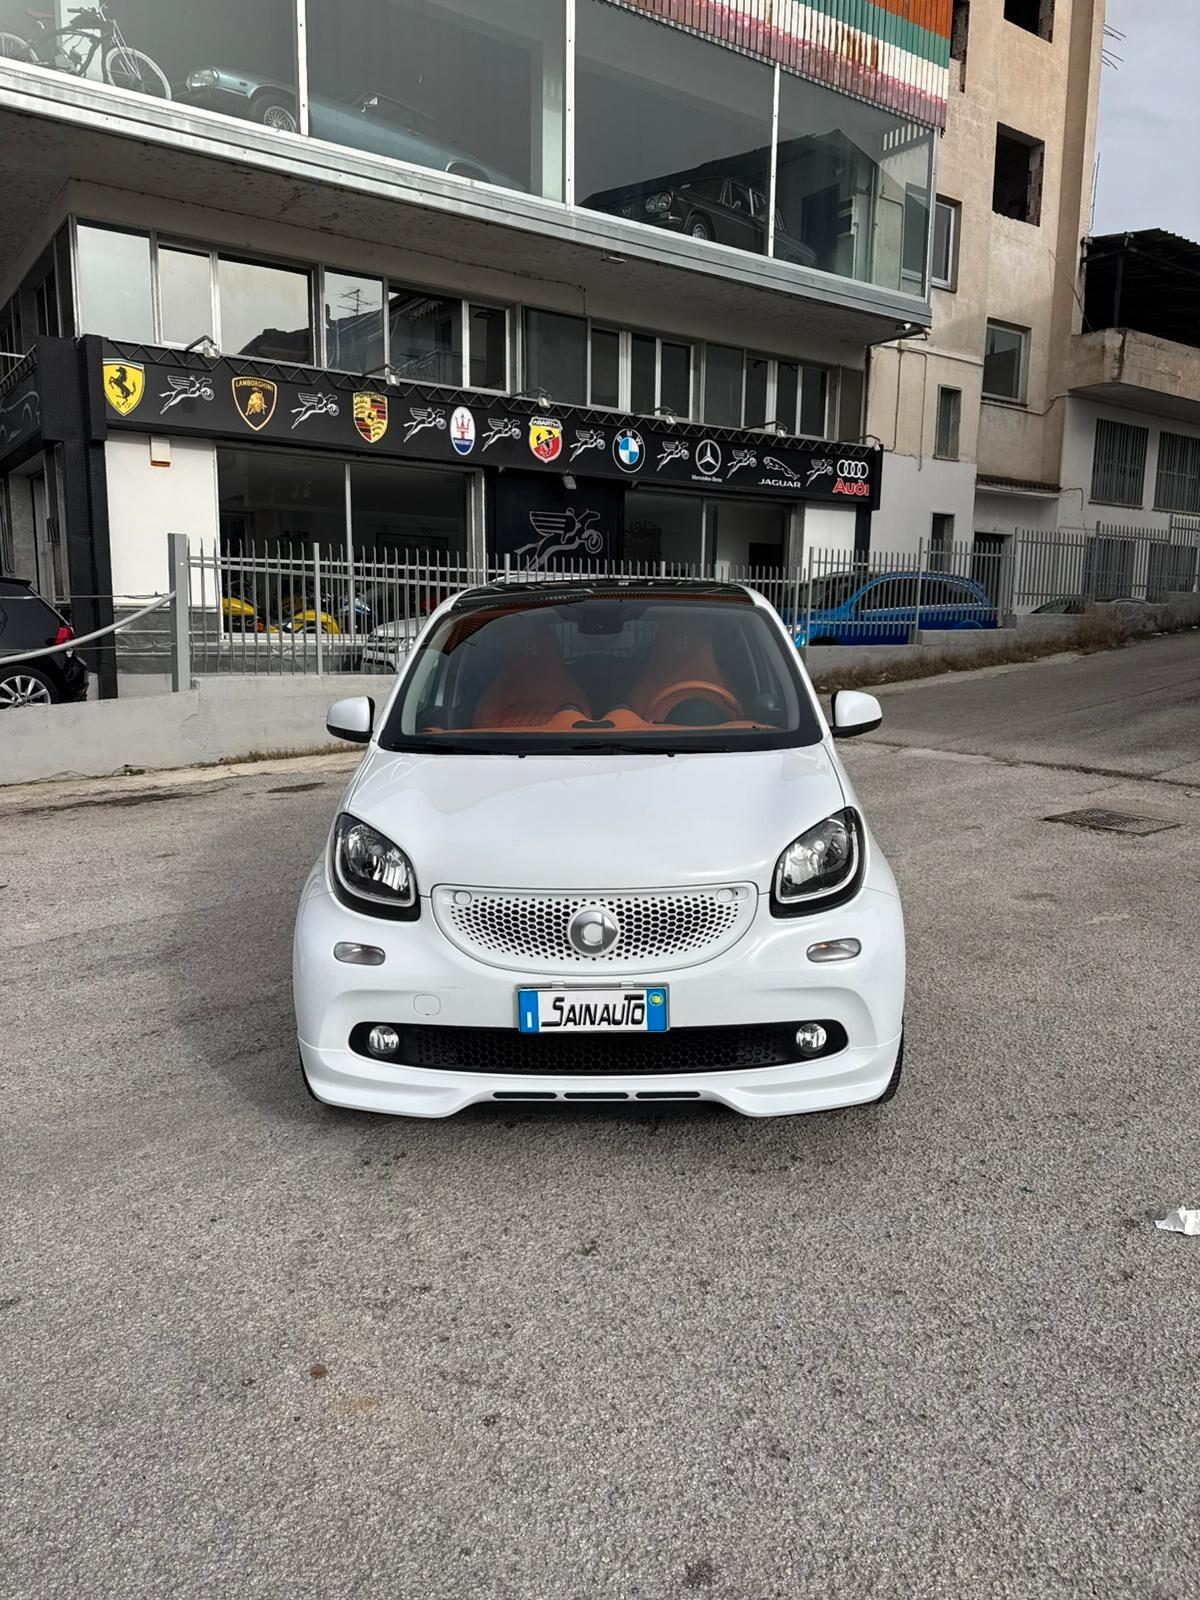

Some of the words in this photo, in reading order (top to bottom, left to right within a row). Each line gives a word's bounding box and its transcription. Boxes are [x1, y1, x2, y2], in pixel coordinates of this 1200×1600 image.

[235, 379, 274, 392] LAMBORGHINI
[616, 430, 643, 445] BMW
[758, 478, 801, 488] JAGUAR
[832, 478, 869, 496] Audi
